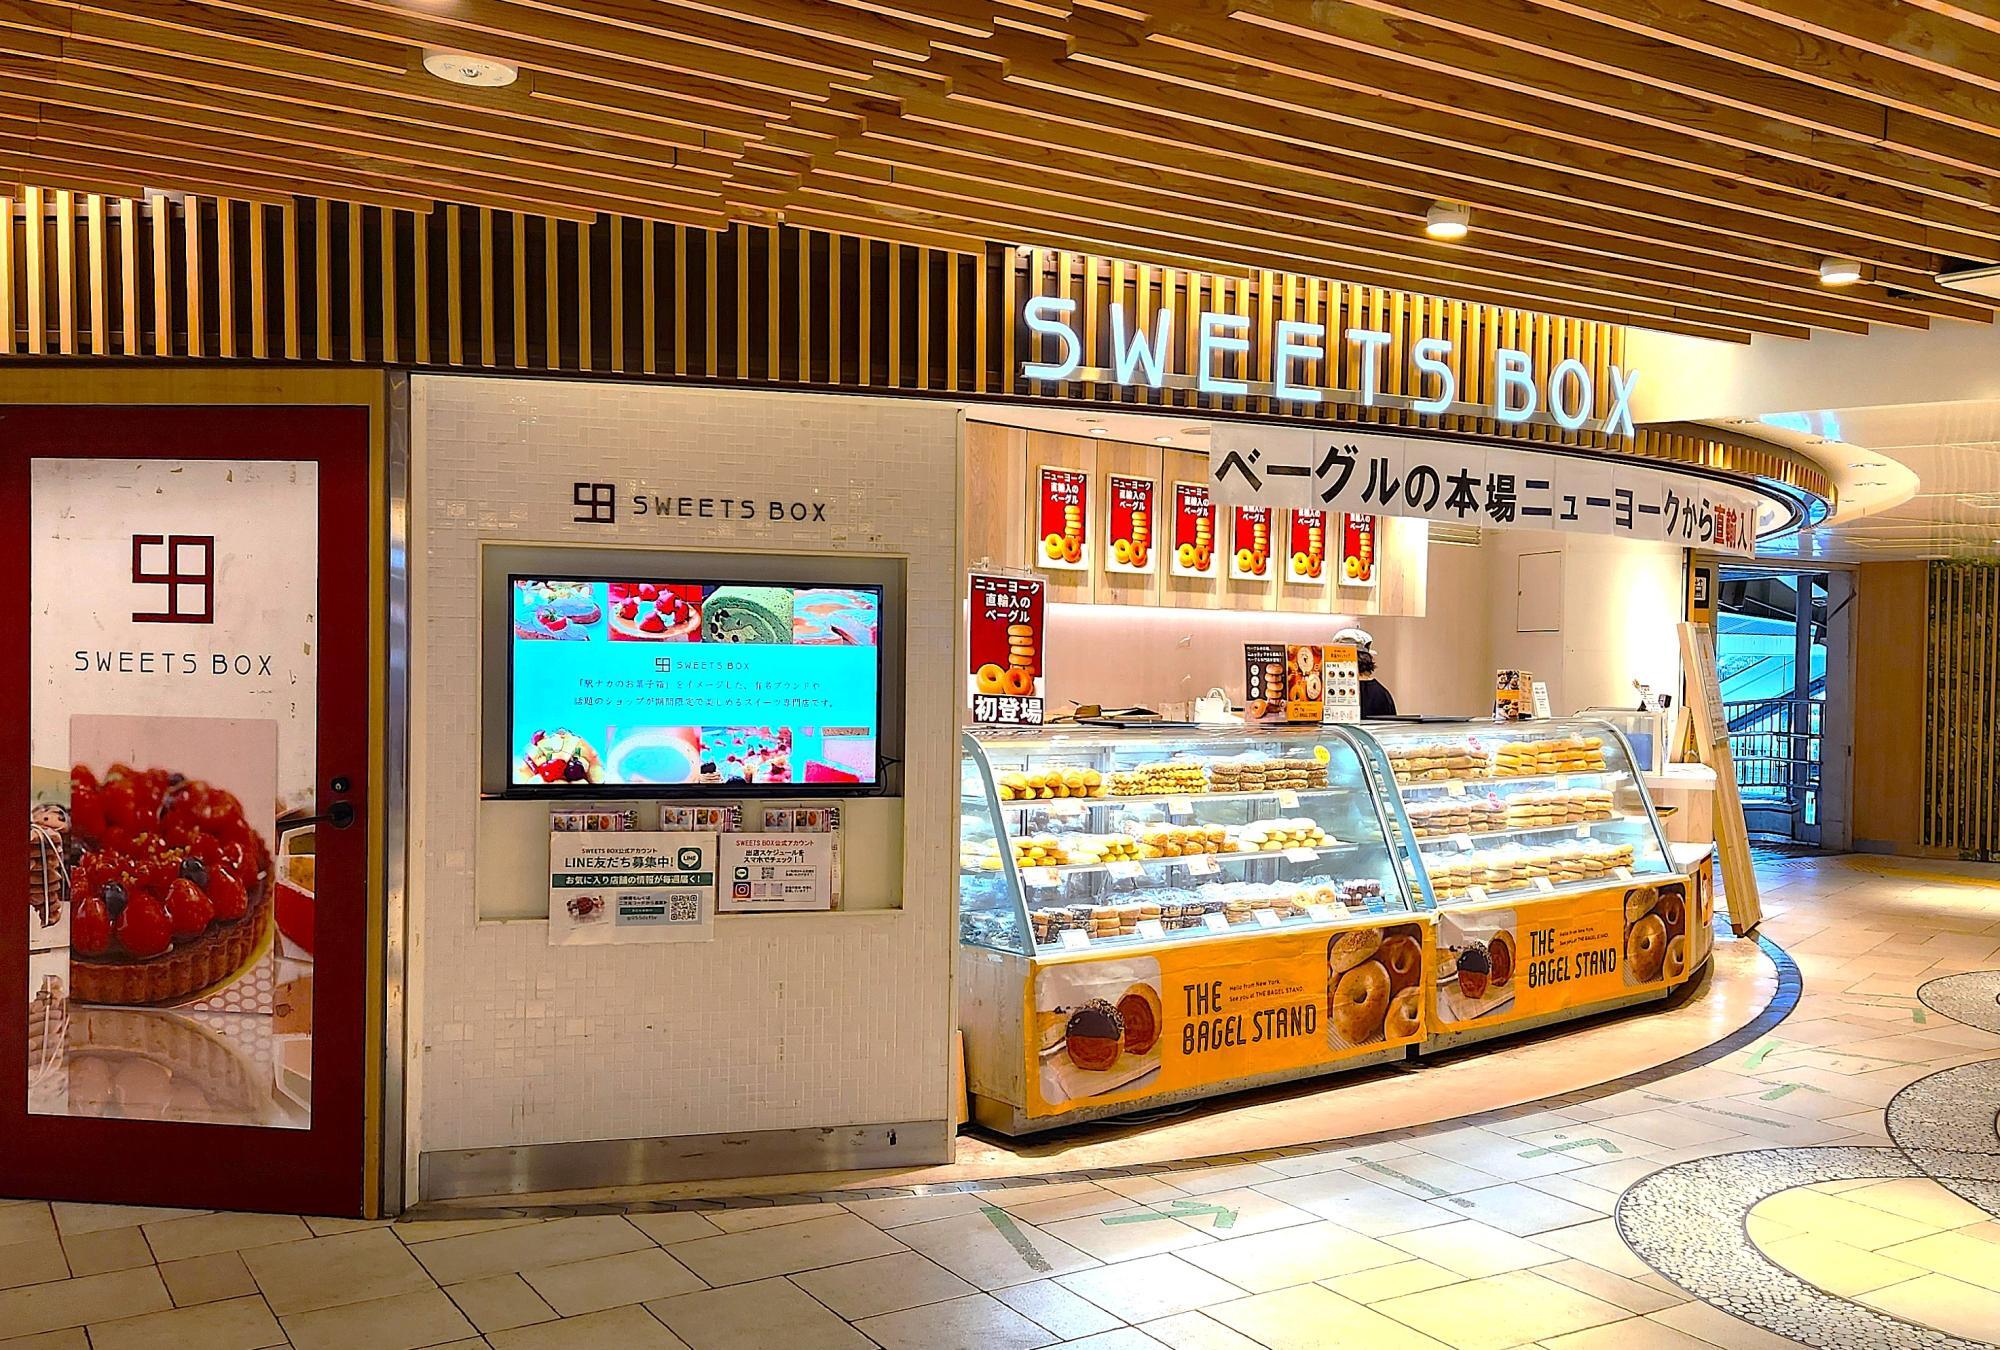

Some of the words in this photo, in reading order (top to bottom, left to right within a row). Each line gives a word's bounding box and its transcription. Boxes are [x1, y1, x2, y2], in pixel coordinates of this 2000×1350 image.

[1022, 296, 1455, 415] SWEETS
[1495, 348, 1639, 438] BOX
[1043, 471, 1085, 484] ニューヨーク
[1050, 482, 1079, 494] 直輸入の
[1112, 479, 1151, 490] ニューヨーク
[1178, 485, 1208, 496] ニューヨー
[1050, 494, 1079, 505] ベーグル
[1119, 489, 1146, 501] 直輸入の
[1214, 444, 1754, 552] ベーグルの本場ニューヨークから直輸入!
[633, 495, 755, 519] SWEETS
[769, 501, 826, 522] BOX
[1119, 501, 1146, 511] ベーグル
[1184, 507, 1209, 517] ベーグル
[1242, 514, 1265, 523] ベーグル
[1298, 517, 1320, 527] ベーグル
[1350, 522, 1370, 532] ベーグル
[975, 578, 1040, 595] ニューヨーク
[985, 592, 1030, 609] 直輸入の
[985, 609, 1030, 623] ベーグル
[75, 651, 197, 674] SWEETS
[212, 654, 272, 676] BOX
[676, 661, 723, 670] SWEETS
[727, 661, 750, 670] BOX
[975, 695, 1042, 724] 初登場
[762, 839, 814, 847] BOX公式アカウント
[745, 849, 805, 857] 出店スケジュールを
[565, 856, 674, 868] LINE友だち募集中!
[565, 875, 701, 886] お気に入り店舗の情報が毎週届く!
[1529, 927, 1556, 958] THE
[1528, 955, 1571, 988] BAGEL
[1574, 947, 1617, 979] STAND
[1183, 980, 1223, 1017] THE
[1256, 990, 1266, 998] THE
[1267, 988, 1284, 996] BAGEL
[1182, 1014, 1247, 1055] BAGEL
[1252, 1004, 1317, 1043] STAND
